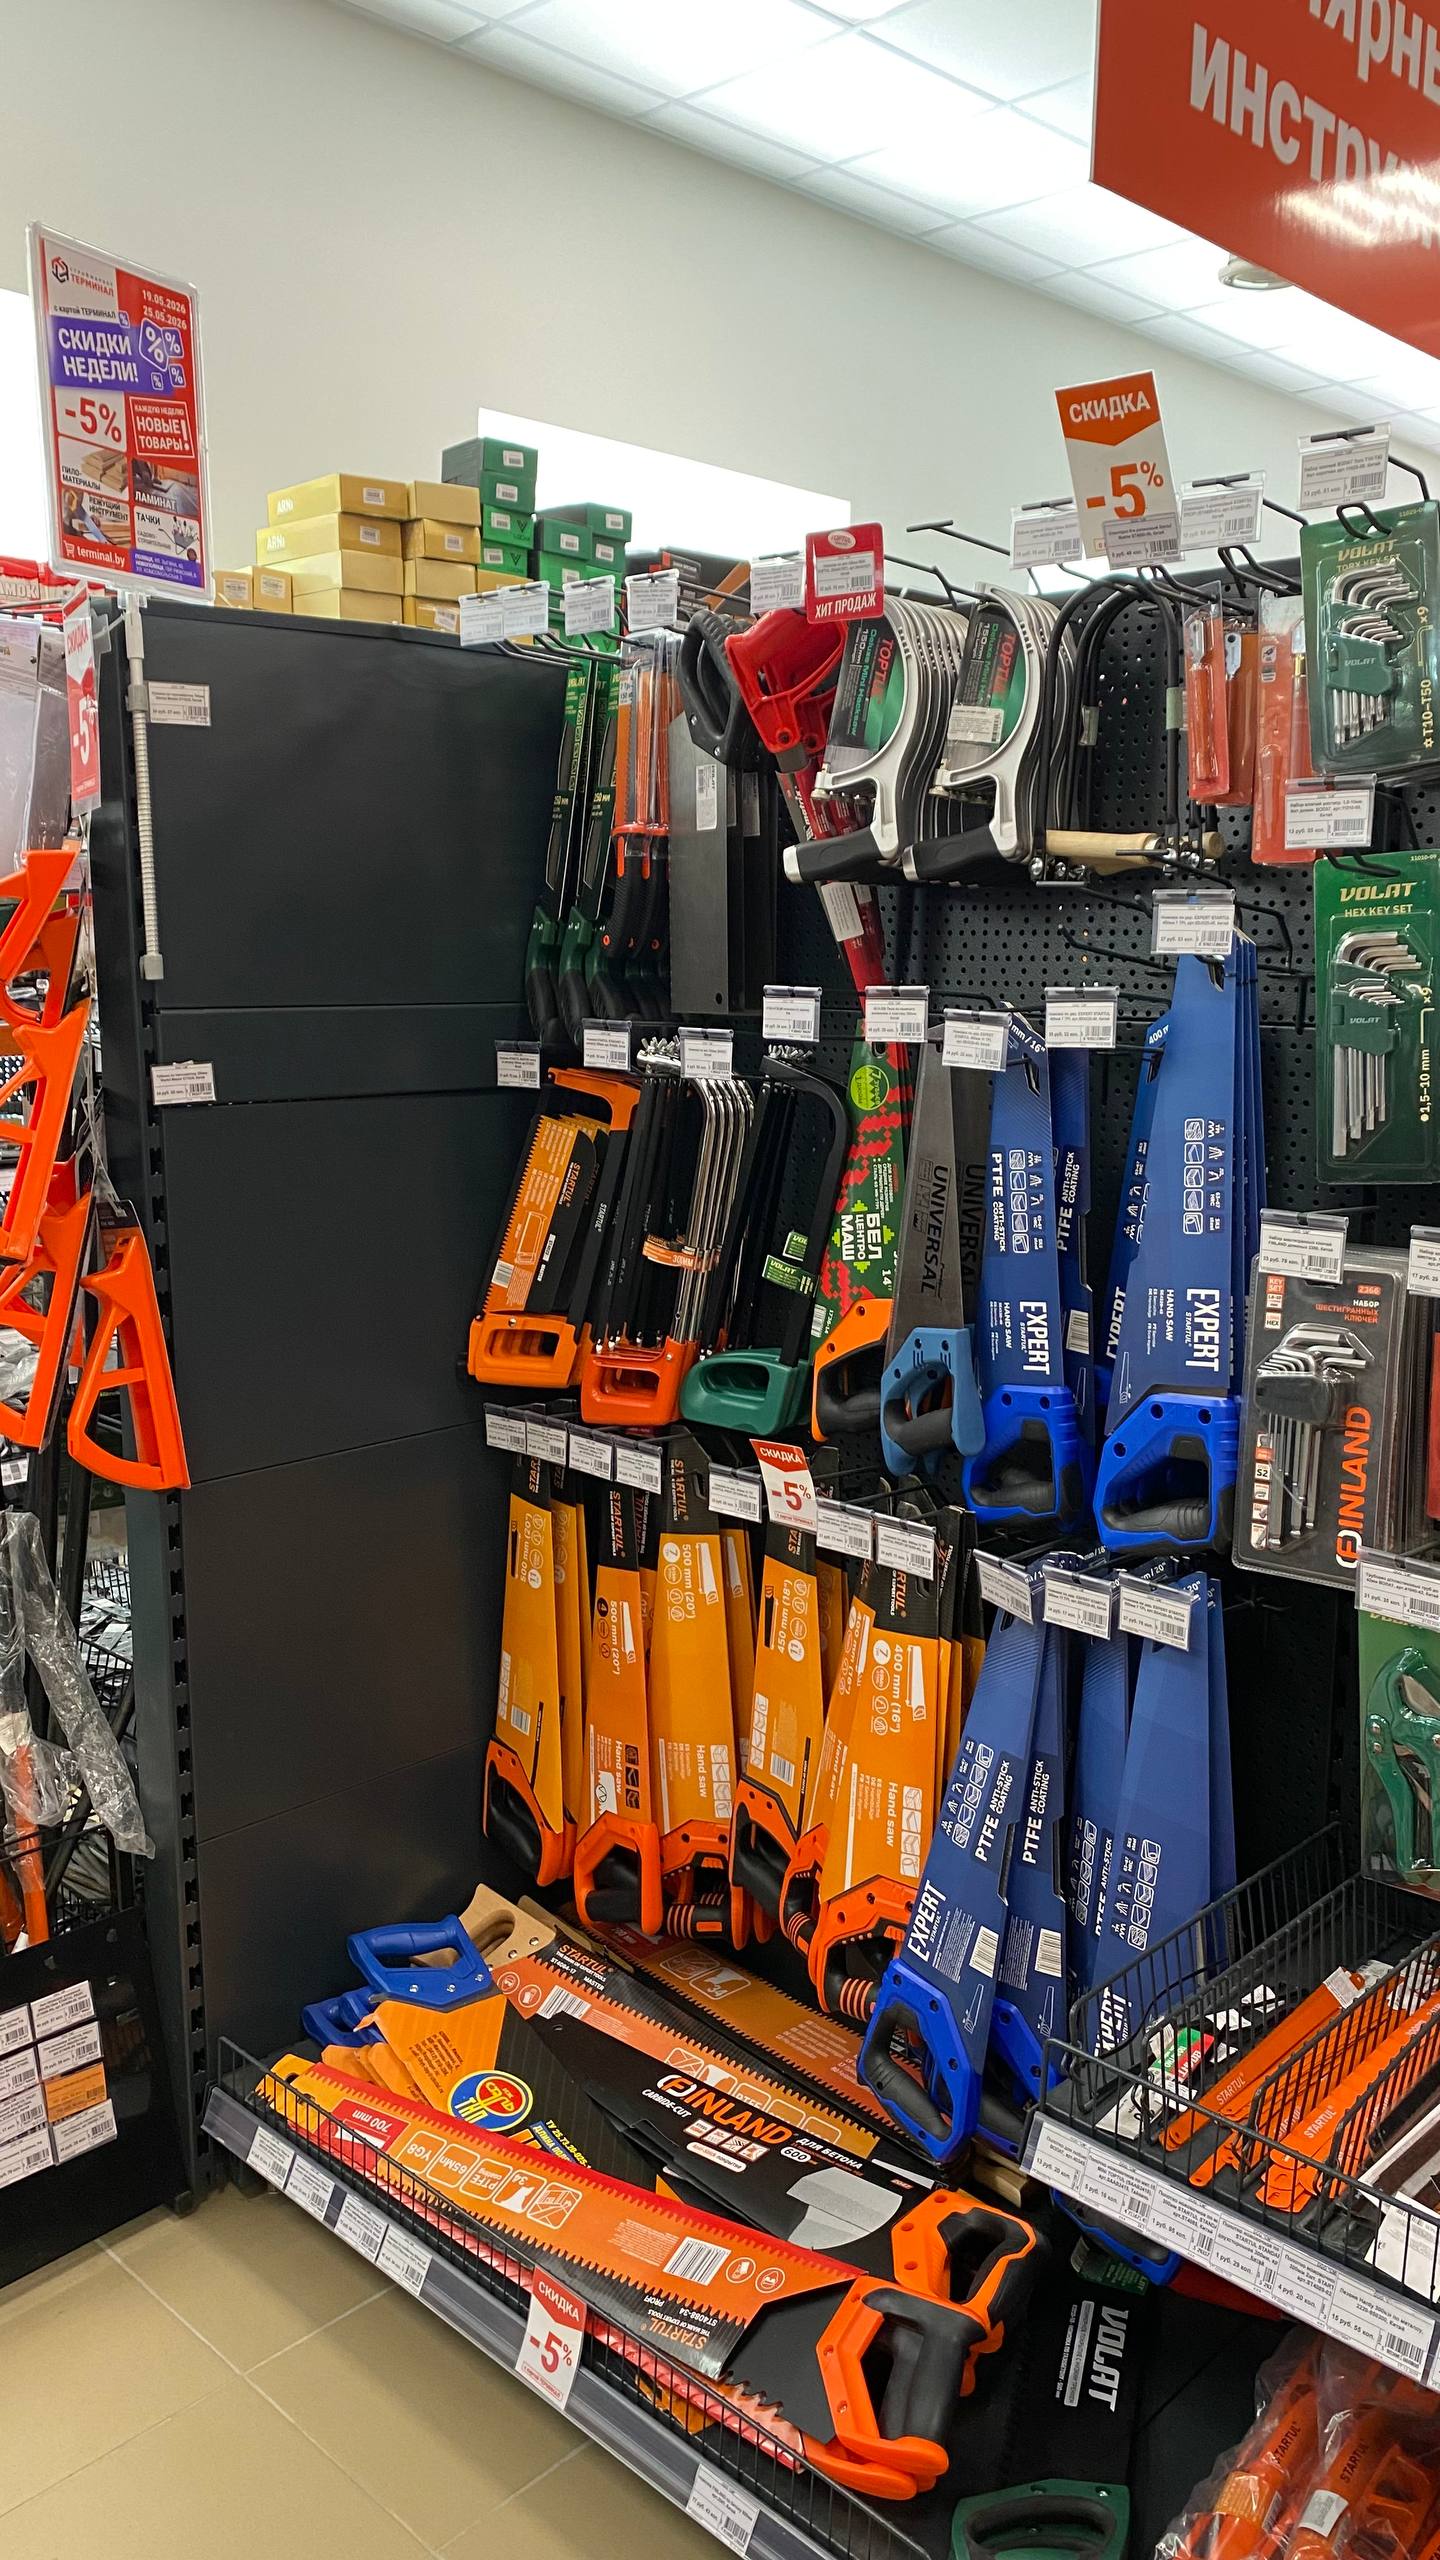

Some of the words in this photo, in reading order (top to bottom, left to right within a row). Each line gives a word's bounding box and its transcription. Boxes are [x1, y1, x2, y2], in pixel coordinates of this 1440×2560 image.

[70, 273, 115, 297] ТЕРМИНАЛ
[59, 305, 81, 315] картой
[81, 307, 117, 319] ТЕРМИНАЛ
[142, 289, 187, 314] 19.05.2026
[143, 305, 188, 330] 25.05.2026
[58, 327, 132, 358] СКИДКИ
[63, 355, 139, 383] НЕДЕЛИ!
[134, 402, 160, 414] КАЖДУЮ
[161, 405, 185, 416] НЕДЕЛЮ
[1068, 390, 1151, 423] СКИДКА
[65, 397, 122, 443] -5%
[136, 416, 181, 434] НОВЫЕ
[61, 465, 82, 477] ПИЛО-
[62, 473, 101, 491] МАТЕРИАЛЫ
[135, 491, 177, 511] ЛАМИНАТ
[1086, 461, 1164, 519] -5%
[88, 495, 122, 511] РЕЖУЩИЙ
[89, 505, 129, 521] ИНСТРУМЕНТ
[136, 511, 161, 525] ТАЧКИ
[77, 545, 126, 568] terminal.by
[1337, 539, 1399, 561] VOLAT
[815, 601, 833, 619] ХИТ
[835, 592, 876, 614] ПРОДАЖ
[67, 624, 89, 655] СКИДКА
[864, 628, 877, 663] Deluxe
[1344, 656, 1377, 666] VOLAT
[861, 665, 869, 687] Mini
[1340, 881, 1418, 903] VOLAT
[1344, 907, 1366, 918] HEX
[1369, 905, 1390, 916] KEY
[1393, 903, 1413, 914] SET
[1350, 1016, 1381, 1024] VOLAT
[1030, 1038, 1046, 1053] 16"
[1421, 1049, 1430, 1072] mm
[565, 1162, 581, 1206] STARTUL
[1061, 1152, 1075, 1203] ANTI-STICK
[1068, 1164, 1080, 1204] COATING
[992, 1152, 1004, 1197] PTFE
[998, 1201, 1007, 1253] ANTI-STICK
[594, 1202, 607, 1230] STARTUL
[992, 1201, 1000, 1241] COATING
[840, 1214, 855, 1261] МАШ
[855, 1215, 867, 1260] ЦЕНТРО
[866, 1213, 883, 1260] БЕЛ
[920, 1165, 949, 1295] UNIVERSAL
[1056, 1206, 1073, 1252] PTFE
[769, 1259, 797, 1275] VOLAT
[1269, 1278, 1283, 1286] KEY
[1269, 1284, 1282, 1293] SET
[1166, 1289, 1174, 1319] HAND
[1315, 1303, 1379, 1317] ШЕСТИГРАННЫХ
[1353, 1299, 1379, 1308] НАБОР
[1165, 1319, 1174, 1342] SAW
[1184, 1311, 1192, 1348] STARTUL
[1185, 1288, 1220, 1373] EXPERT
[1266, 1319, 1280, 1327] HEX
[1344, 1314, 1378, 1324] КЛЮЧЕЙ
[1019, 1301, 1051, 1376] EXPERT
[1020, 1321, 1028, 1354] STARTUL
[759, 1446, 803, 1465] СКИДКА
[1256, 1468, 1268, 1477] S2
[771, 1481, 812, 1511] -5%
[1335, 1405, 1373, 1569] FINLAND
[612, 1490, 624, 1554] STARTUL
[523, 1540, 529, 1558] mm
[682, 1544, 692, 1566] 500
[683, 1568, 692, 1589] mm
[684, 1591, 696, 1620] (20")
[783, 1579, 793, 1609] (18")
[610, 1600, 618, 1623] 500
[779, 1610, 788, 1630] mm
[611, 1624, 618, 1645] mm
[852, 1614, 862, 1638] 400
[777, 1630, 786, 1654] 450
[849, 1638, 858, 1664] mm
[611, 1647, 621, 1675] (20")
[893, 1644, 903, 1672] 400
[892, 1674, 902, 1701] mm
[890, 1702, 901, 1734] (16")
[615, 1740, 623, 1771] Hand
[696, 1744, 708, 1774] Hand
[833, 1739, 843, 1773] Hand
[697, 1775, 708, 1798] saw
[996, 1774, 1014, 1815] COATING
[1029, 1760, 1044, 1813] ANTI-STICK
[1036, 1773, 1050, 1815] COATING
[887, 1782, 898, 1818] Hand
[974, 1814, 1000, 1862] PTFE
[989, 1760, 1010, 1812] ANTI-STICK
[886, 1819, 895, 1848] saw
[1022, 1816, 1043, 1865] PTFE
[1100, 1837, 1113, 1889] ANTI-STICK
[907, 1879, 947, 1962] EXPERT
[929, 1911, 942, 1943] STARTUL
[559, 1944, 608, 1976] STARTUL
[583, 1975, 605, 1992] MASTER
[707, 1983, 728, 1997] 34
[1216, 2073, 1245, 2105] STARTUL
[641, 2087, 692, 2119] CARBIDE-CUT
[656, 2073, 793, 2144] FINLAND
[352, 2109, 370, 2125] mm
[369, 2117, 393, 2134] 700
[1303, 2107, 1337, 2139] STARTUL
[406, 2143, 430, 2161] YG8
[438, 2154, 468, 2175] 65Mn
[782, 2146, 808, 2162] 600
[795, 2136, 824, 2152] ДЛЯ
[823, 2145, 864, 2171] БЕТОНА
[471, 2173, 499, 2192] PTFE
[478, 2167, 503, 2181] coating
[511, 2172, 529, 2184] 34
[1107, 2195, 1119, 2205] коп.
[1156, 2220, 1167, 2231] руб.
[1175, 2231, 1187, 2241] коп.
[1220, 2255, 1233, 2266] руб.
[1240, 2263, 1252, 2274] коп.
[537, 2279, 580, 2322] СКИДКА
[643, 2294, 665, 2307] PROFI
[1283, 2286, 1295, 2298] руб.
[1295, 2292, 1304, 2301] 20
[1304, 2297, 1317, 2309] коп.
[647, 2308, 664, 2321] TOOLS
[663, 2314, 681, 2327] EXPERT
[678, 2307, 718, 2328] ST4088-34
[1331, 2312, 1339, 2321] 15
[1339, 2316, 1353, 2329] руб.
[1353, 2324, 1362, 2333] 55
[1362, 2329, 1375, 2340] коп.
[648, 2317, 708, 2350] STARTUL
[684, 2321, 701, 2334] MARK
[699, 2327, 711, 2337] THE
[529, 2331, 573, 2374] -5%
[1088, 2305, 1129, 2413] VOLAT
[1340, 2440, 1370, 2484] STARTUL
